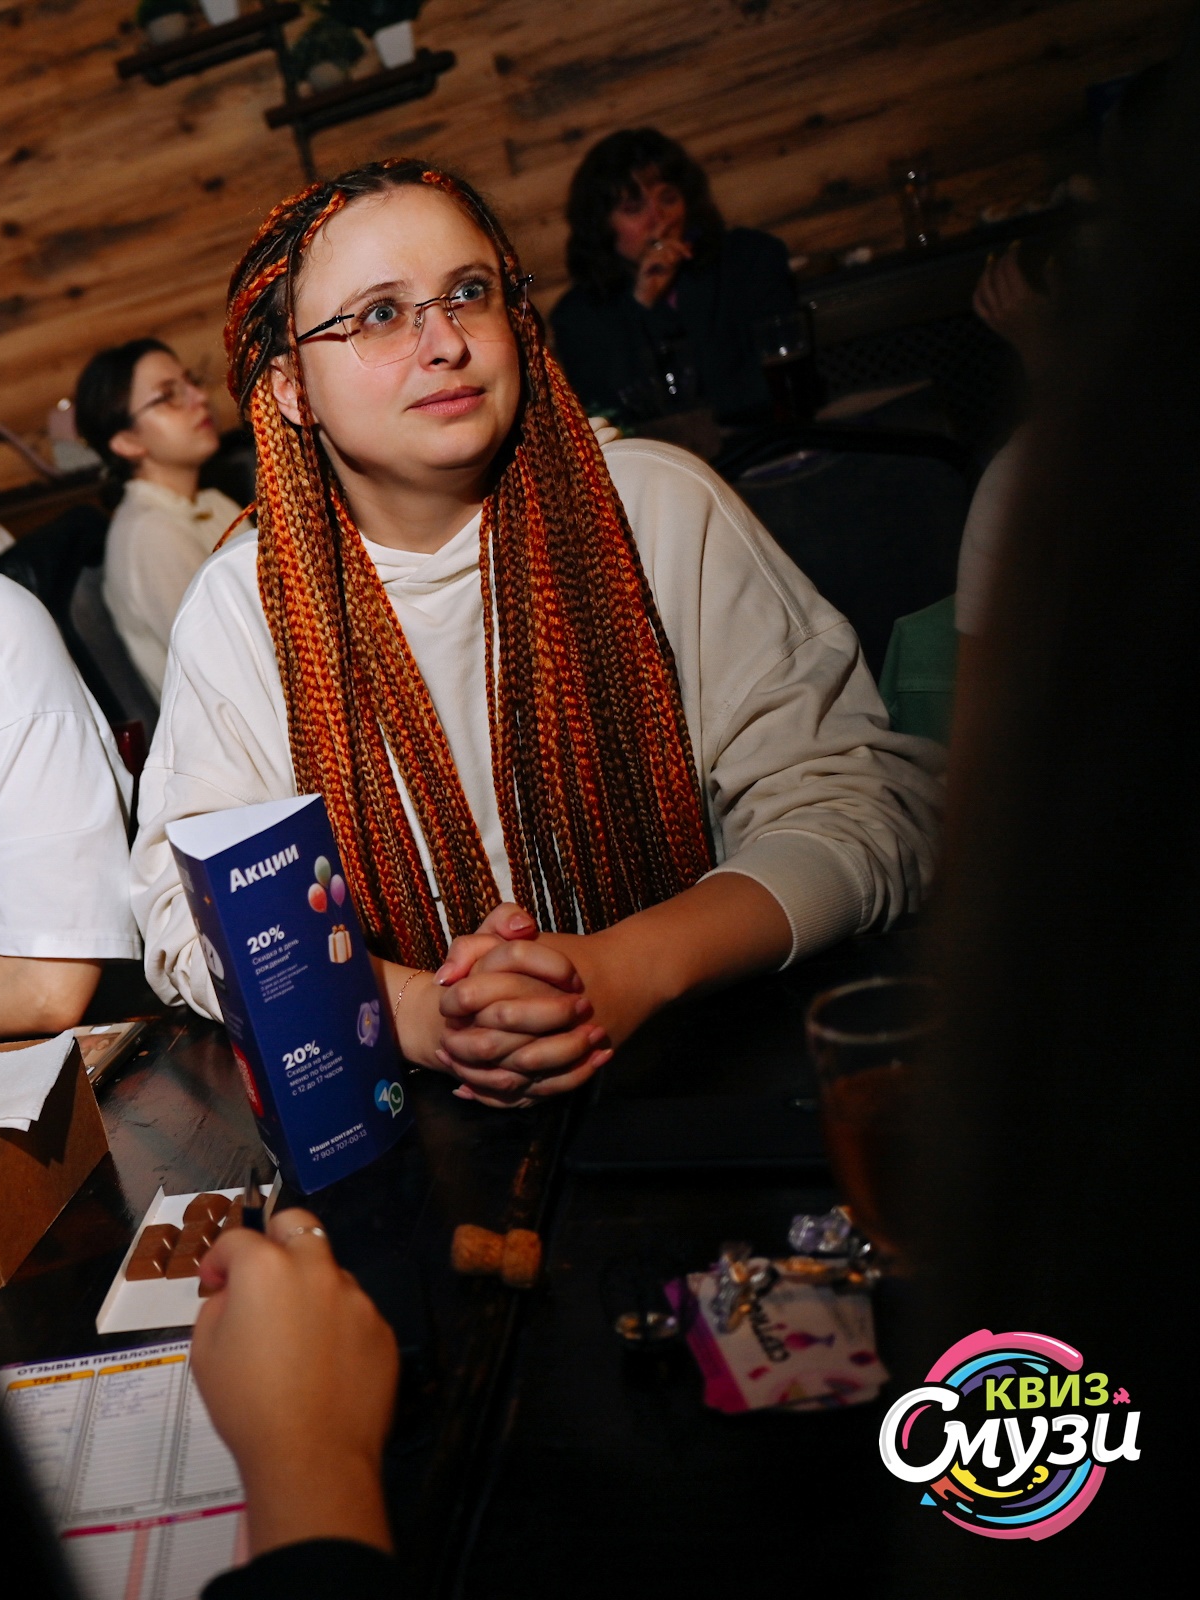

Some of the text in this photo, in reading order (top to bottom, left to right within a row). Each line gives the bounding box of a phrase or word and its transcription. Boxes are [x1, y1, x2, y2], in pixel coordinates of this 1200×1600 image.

[230, 844, 300, 893] Акции
[246, 924, 285, 955] 20%
[252, 949, 278, 966] Скидка
[283, 939, 300, 951] день
[282, 1040, 320, 1070] 20%
[286, 1062, 312, 1078] Скидка
[313, 1057, 322, 1065] на
[289, 1056, 343, 1087] меню по будням
[298, 1084, 306, 1093] 12
[306, 1081, 316, 1090] до
[316, 1075, 323, 1084] 17
[324, 1065, 344, 1079] часов
[309, 1122, 364, 1154] Наши контакты:
[320, 1147, 335, 1159] 903
[17, 1362, 76, 1375] ОТЗЫВЫ
[93, 1343, 189, 1364] ПРЕДЛОЖЕНИ
